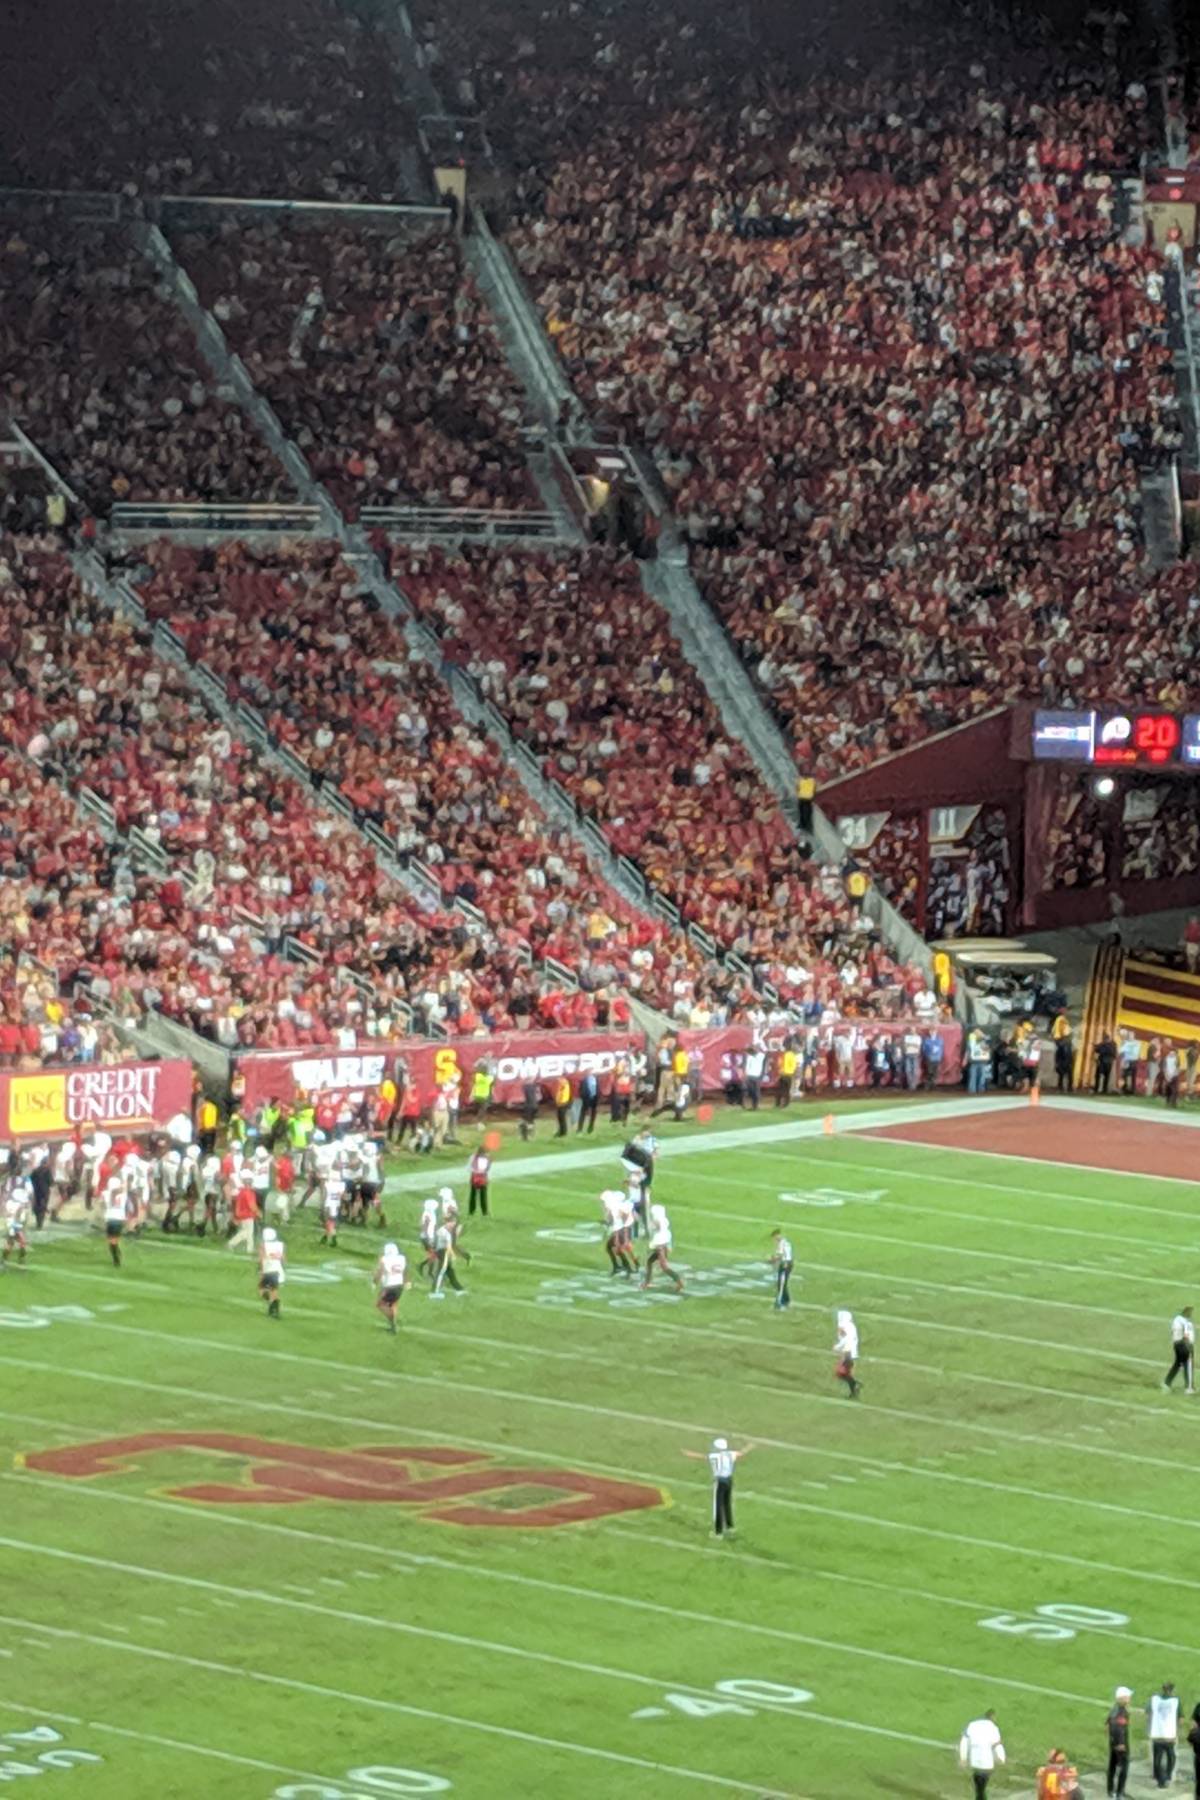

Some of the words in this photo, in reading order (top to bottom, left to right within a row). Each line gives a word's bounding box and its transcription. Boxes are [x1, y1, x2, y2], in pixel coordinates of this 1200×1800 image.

[1136, 715, 1175, 747] 20
[67, 1066, 161, 1096] CREDIT
[14, 1089, 63, 1115] USC
[68, 1091, 153, 1121] UNION
[978, 1603, 1130, 1640] 50
[664, 1679, 815, 1717] 40
